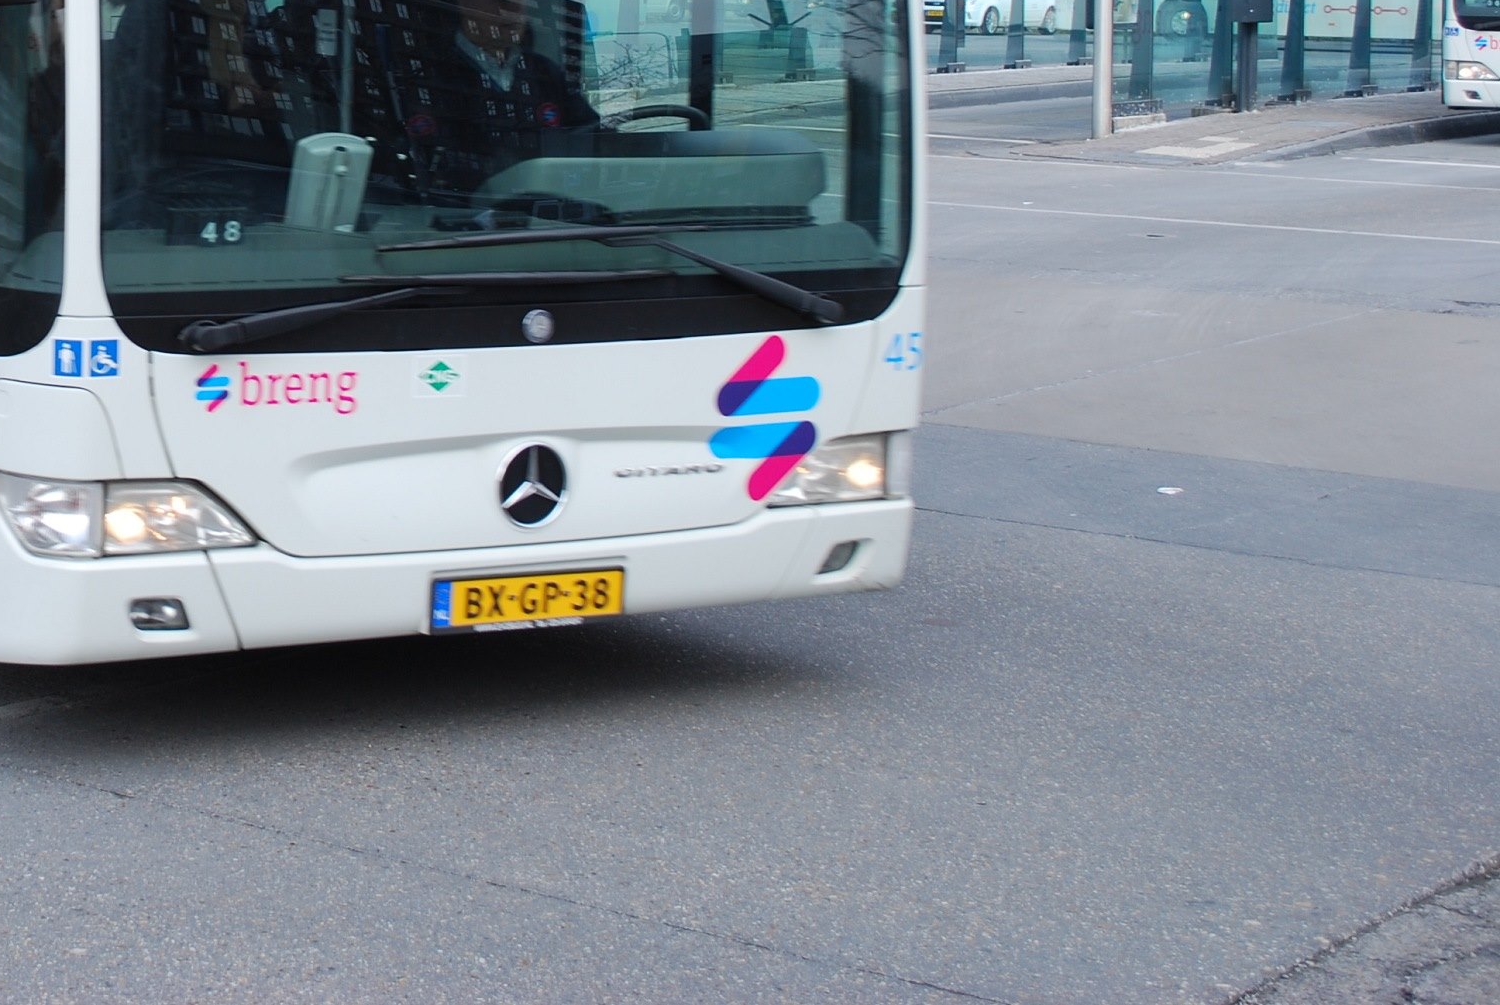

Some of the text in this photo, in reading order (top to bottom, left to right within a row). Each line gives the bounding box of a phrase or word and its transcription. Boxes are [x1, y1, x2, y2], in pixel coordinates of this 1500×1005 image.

[1276, 0, 1316, 14] dict
[200, 220, 241, 243] 48
[238, 361, 360, 414] breng
[464, 578, 610, 619] BX-GP-38
